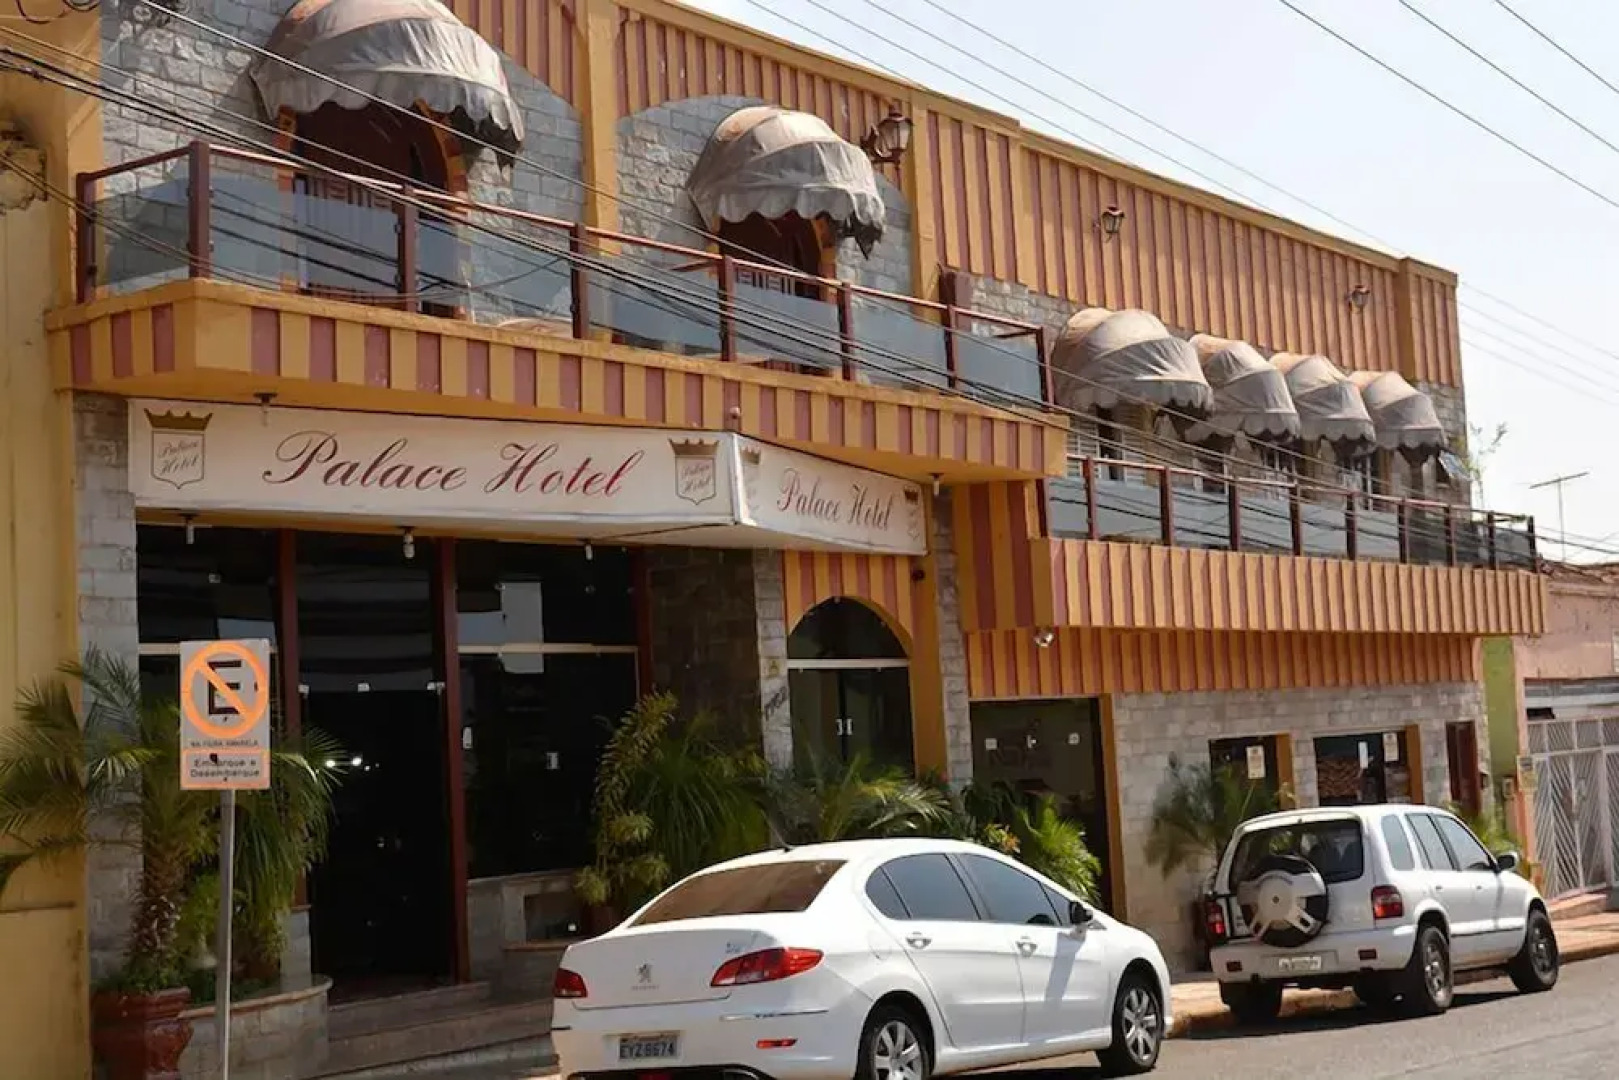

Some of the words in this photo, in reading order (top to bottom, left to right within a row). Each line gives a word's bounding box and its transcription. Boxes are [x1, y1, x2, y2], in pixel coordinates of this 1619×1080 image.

[262, 430, 467, 492] Palace
[484, 441, 645, 498] Hotel
[776, 467, 841, 524] Palace
[848, 480, 893, 532] Hotel
[208, 660, 242, 715] E
[190, 768, 260, 778] Desembarque
